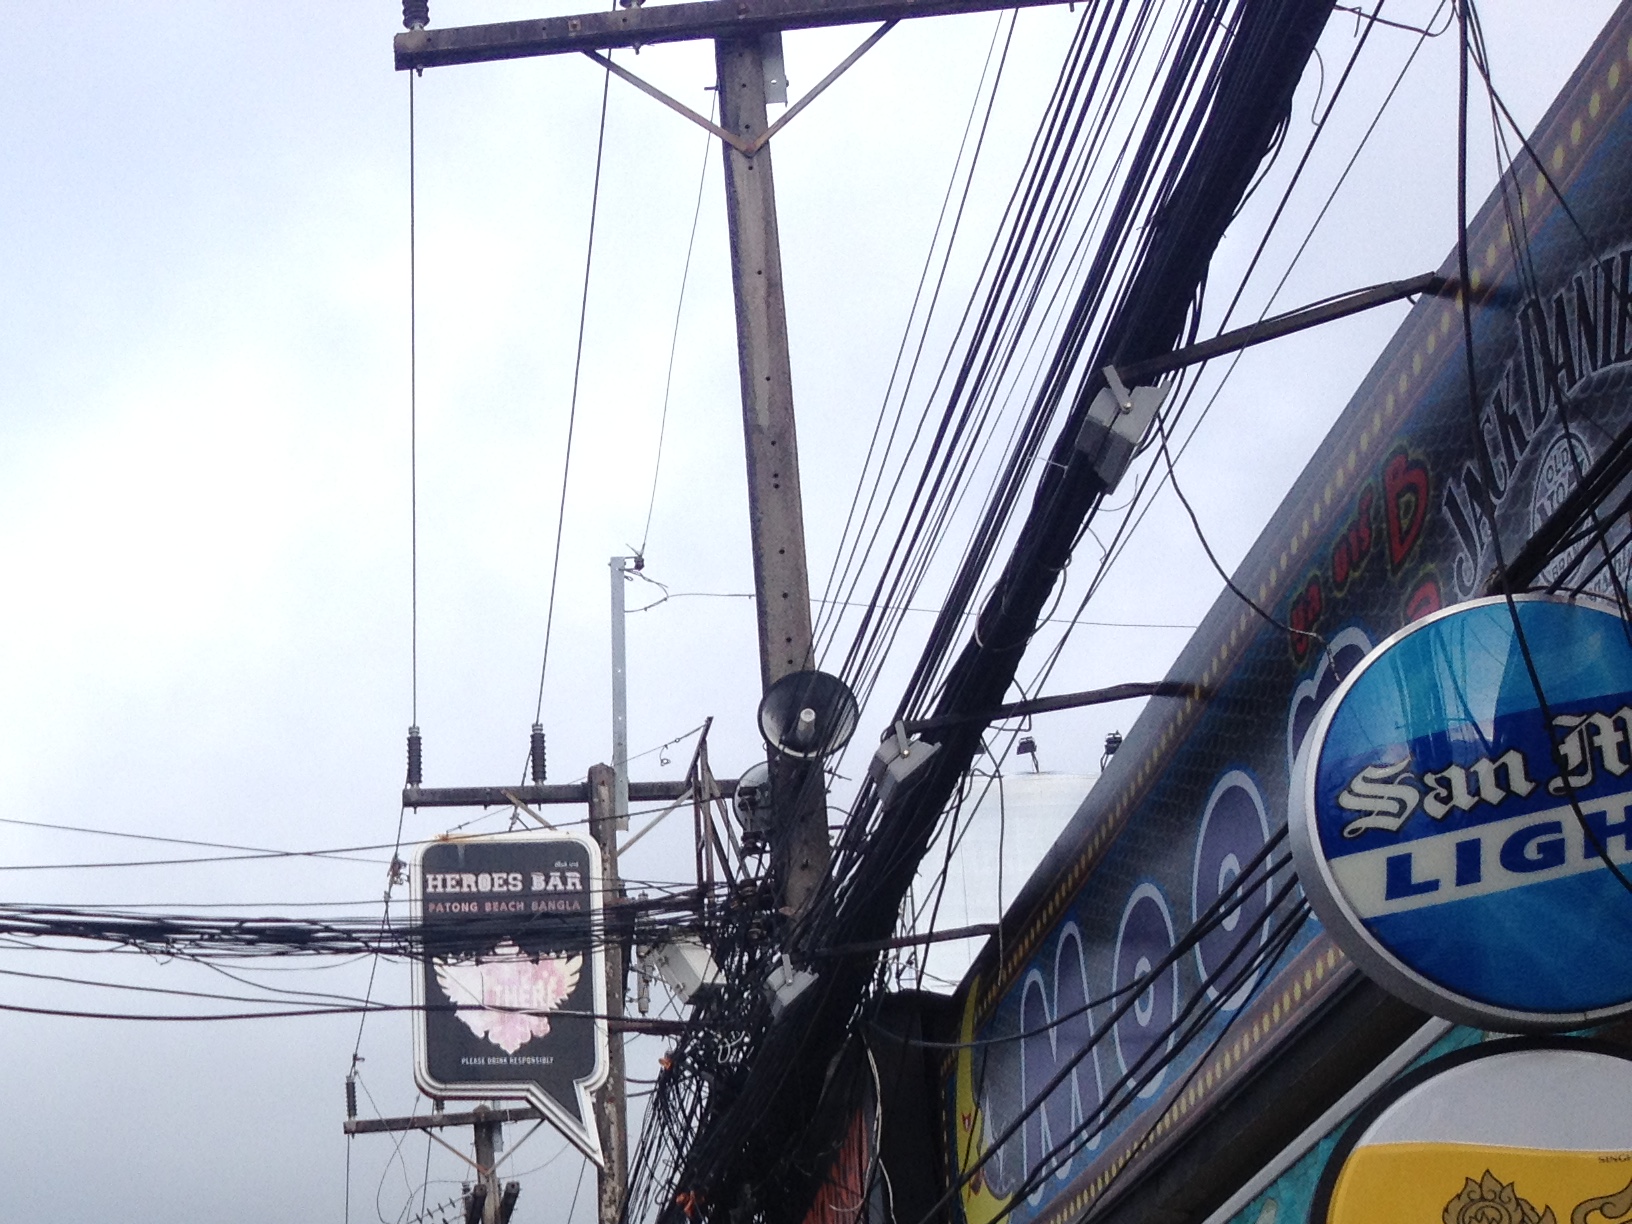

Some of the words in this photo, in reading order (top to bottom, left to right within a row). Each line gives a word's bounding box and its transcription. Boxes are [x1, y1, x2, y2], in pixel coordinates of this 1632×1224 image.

[1337, 748, 1537, 838] San
[1385, 806, 1632, 901] LIGH
[426, 873, 523, 893] HEROES
[531, 872, 583, 891] BAR
[428, 902, 478, 913] PATONG
[485, 901, 524, 912] BEACH
[531, 901, 581, 911] BANGLA
